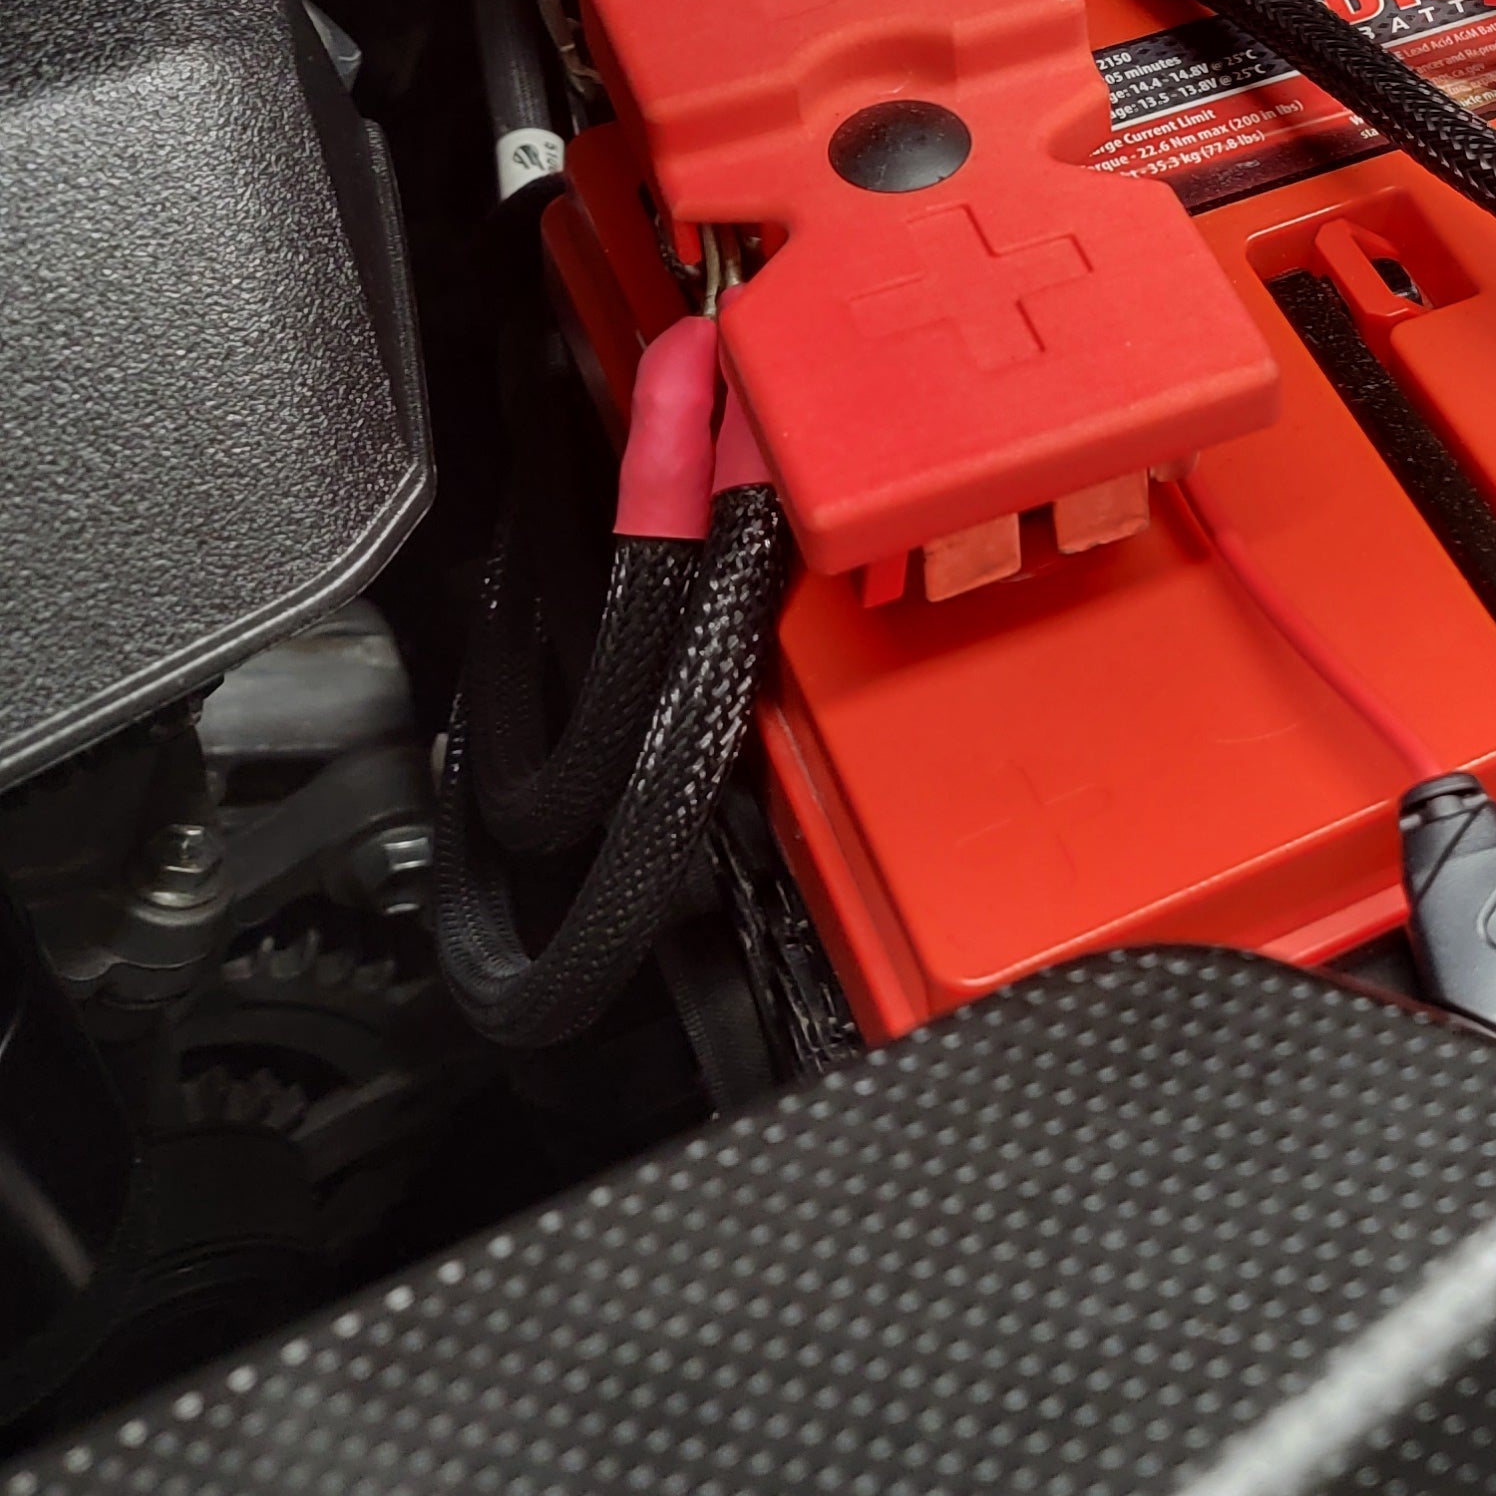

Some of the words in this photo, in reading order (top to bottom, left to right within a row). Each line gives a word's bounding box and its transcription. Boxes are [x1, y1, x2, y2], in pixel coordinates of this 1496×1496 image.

[1402, 43, 1431, 58] Lead
[1453, 27, 1480, 43] AGM
[1102, 71, 1124, 85] 05
[1124, 56, 1182, 80] minutes
[1109, 89, 1131, 105] ge:
[1129, 78, 1163, 95] 14.4
[1169, 63, 1209, 83] 14.8V
[1223, 49, 1259, 66] 25°C
[1137, 92, 1170, 110] 13.5
[1177, 77, 1218, 97] 13.8V
[1219, 75, 1233, 86] @
[1232, 64, 1267, 81] 25°C
[1123, 120, 1179, 145] Current
[1176, 109, 1216, 129] Limit
[1136, 141, 1170, 160] 22.6
[1169, 133, 1198, 149] Nm
[1197, 123, 1230, 141] max
[1228, 113, 1261, 132] (200
[1259, 110, 1277, 120] in
[1275, 99, 1304, 116] lbs)
[1147, 154, 1180, 174] 35.3
[1179, 150, 1202, 164] kg
[1200, 137, 1238, 159] (77.8
[1237, 129, 1266, 147] lbs)
